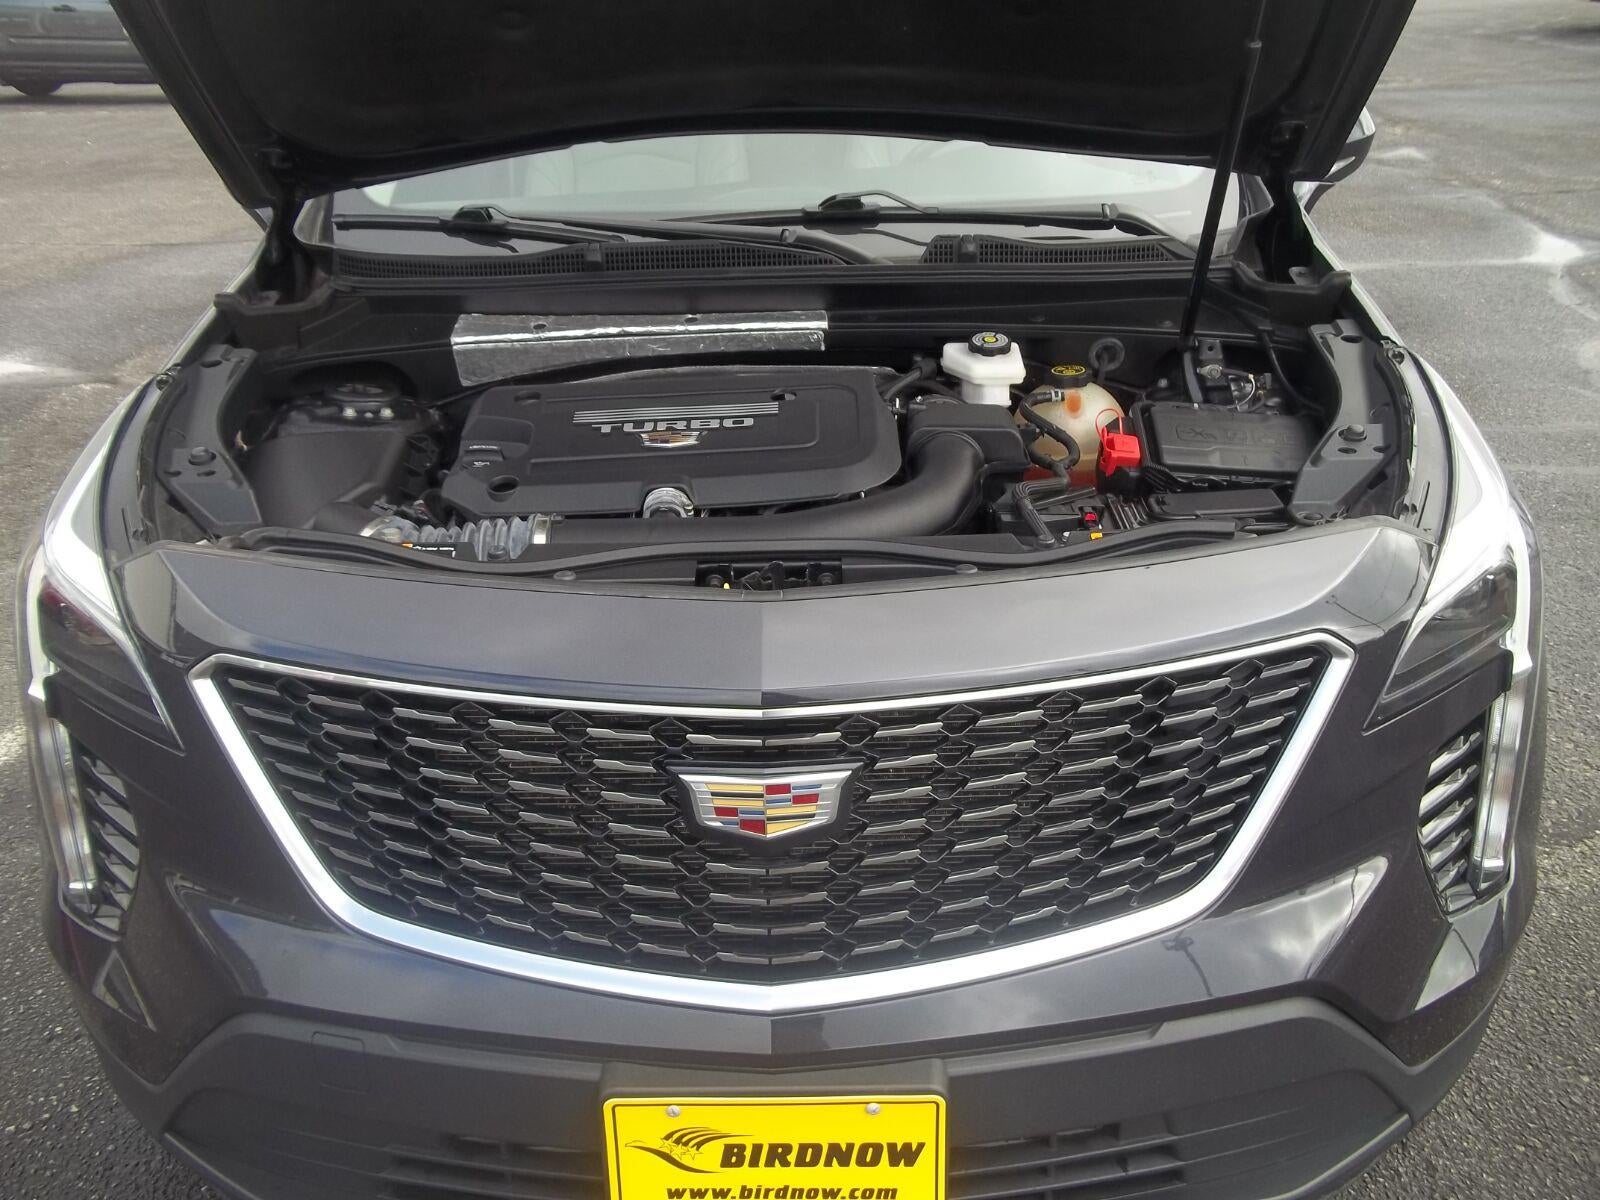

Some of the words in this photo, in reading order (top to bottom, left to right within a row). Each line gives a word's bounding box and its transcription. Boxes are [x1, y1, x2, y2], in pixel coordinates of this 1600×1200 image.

[591, 417, 754, 433] TURBO
[719, 1141, 926, 1168] BIRDNOW
[666, 1184, 898, 1200] www.birdnow.com
